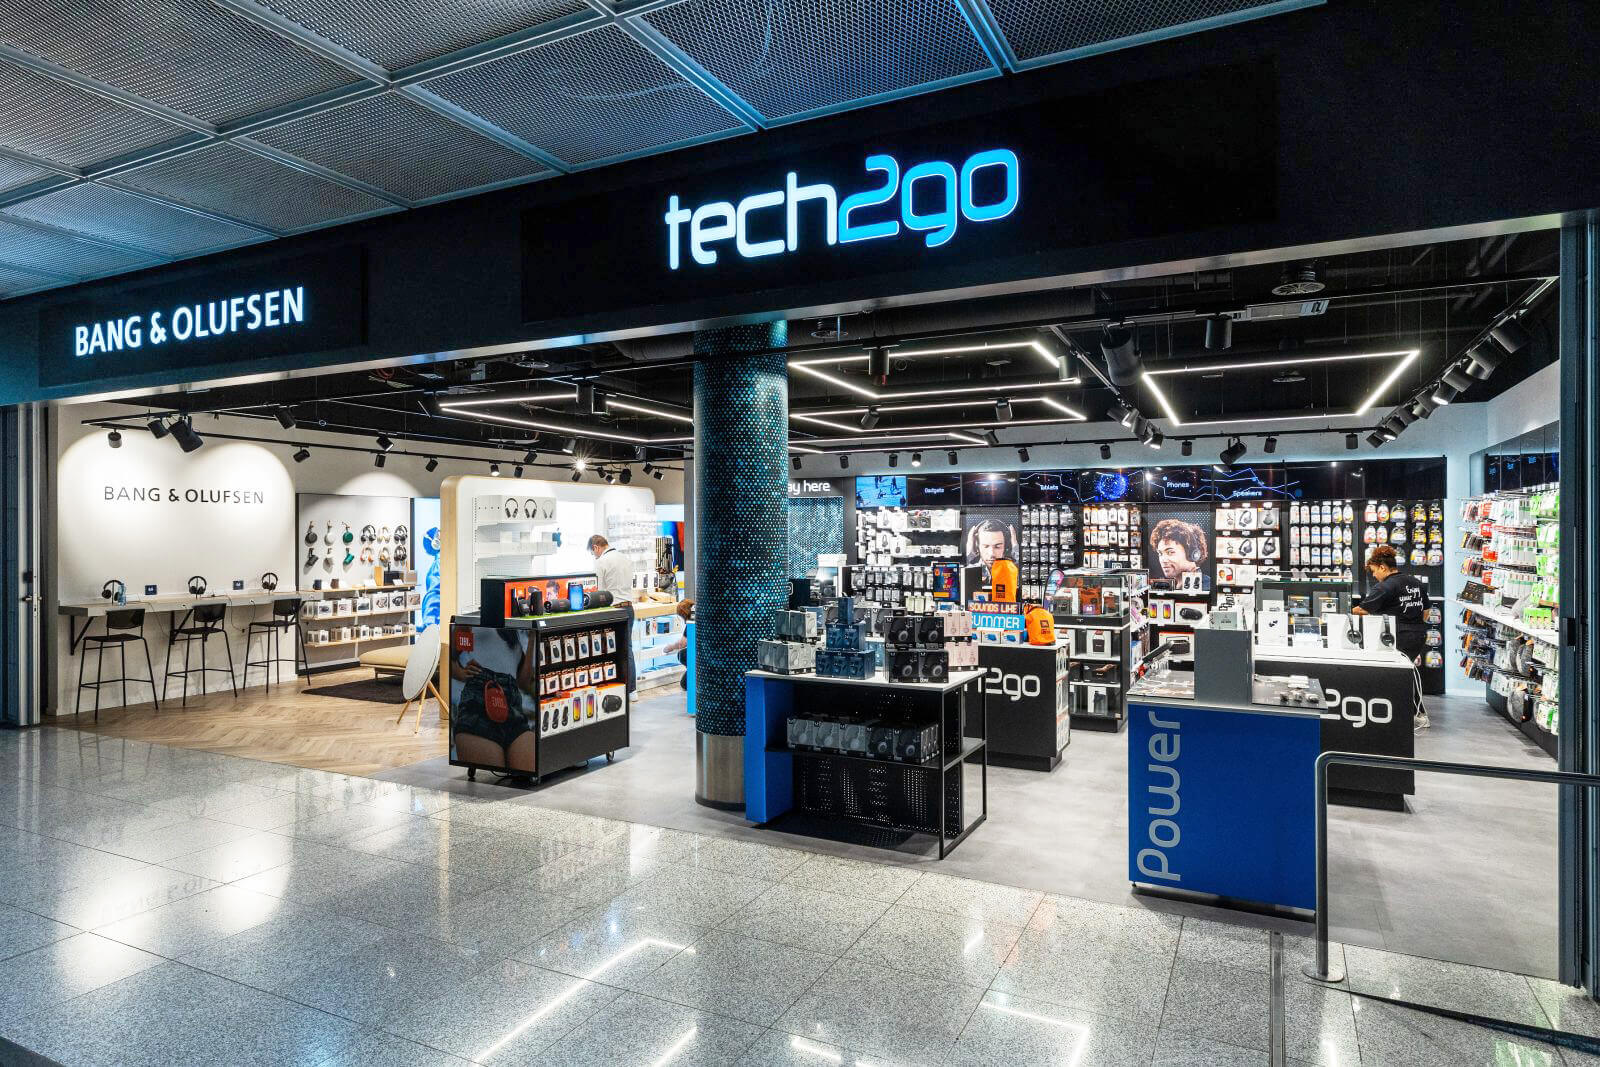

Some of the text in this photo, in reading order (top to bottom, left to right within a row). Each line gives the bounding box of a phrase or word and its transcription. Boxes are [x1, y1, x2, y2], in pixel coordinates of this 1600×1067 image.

[665, 149, 1018, 269] tech2go
[75, 286, 303, 357] BANG & OLUFSEN
[803, 480, 831, 492] here
[104, 486, 264, 504] BANG & OLUFSEN
[1406, 585, 1420, 599] Enjoy
[1399, 596, 1412, 607] your
[459, 636, 471, 647] JBL
